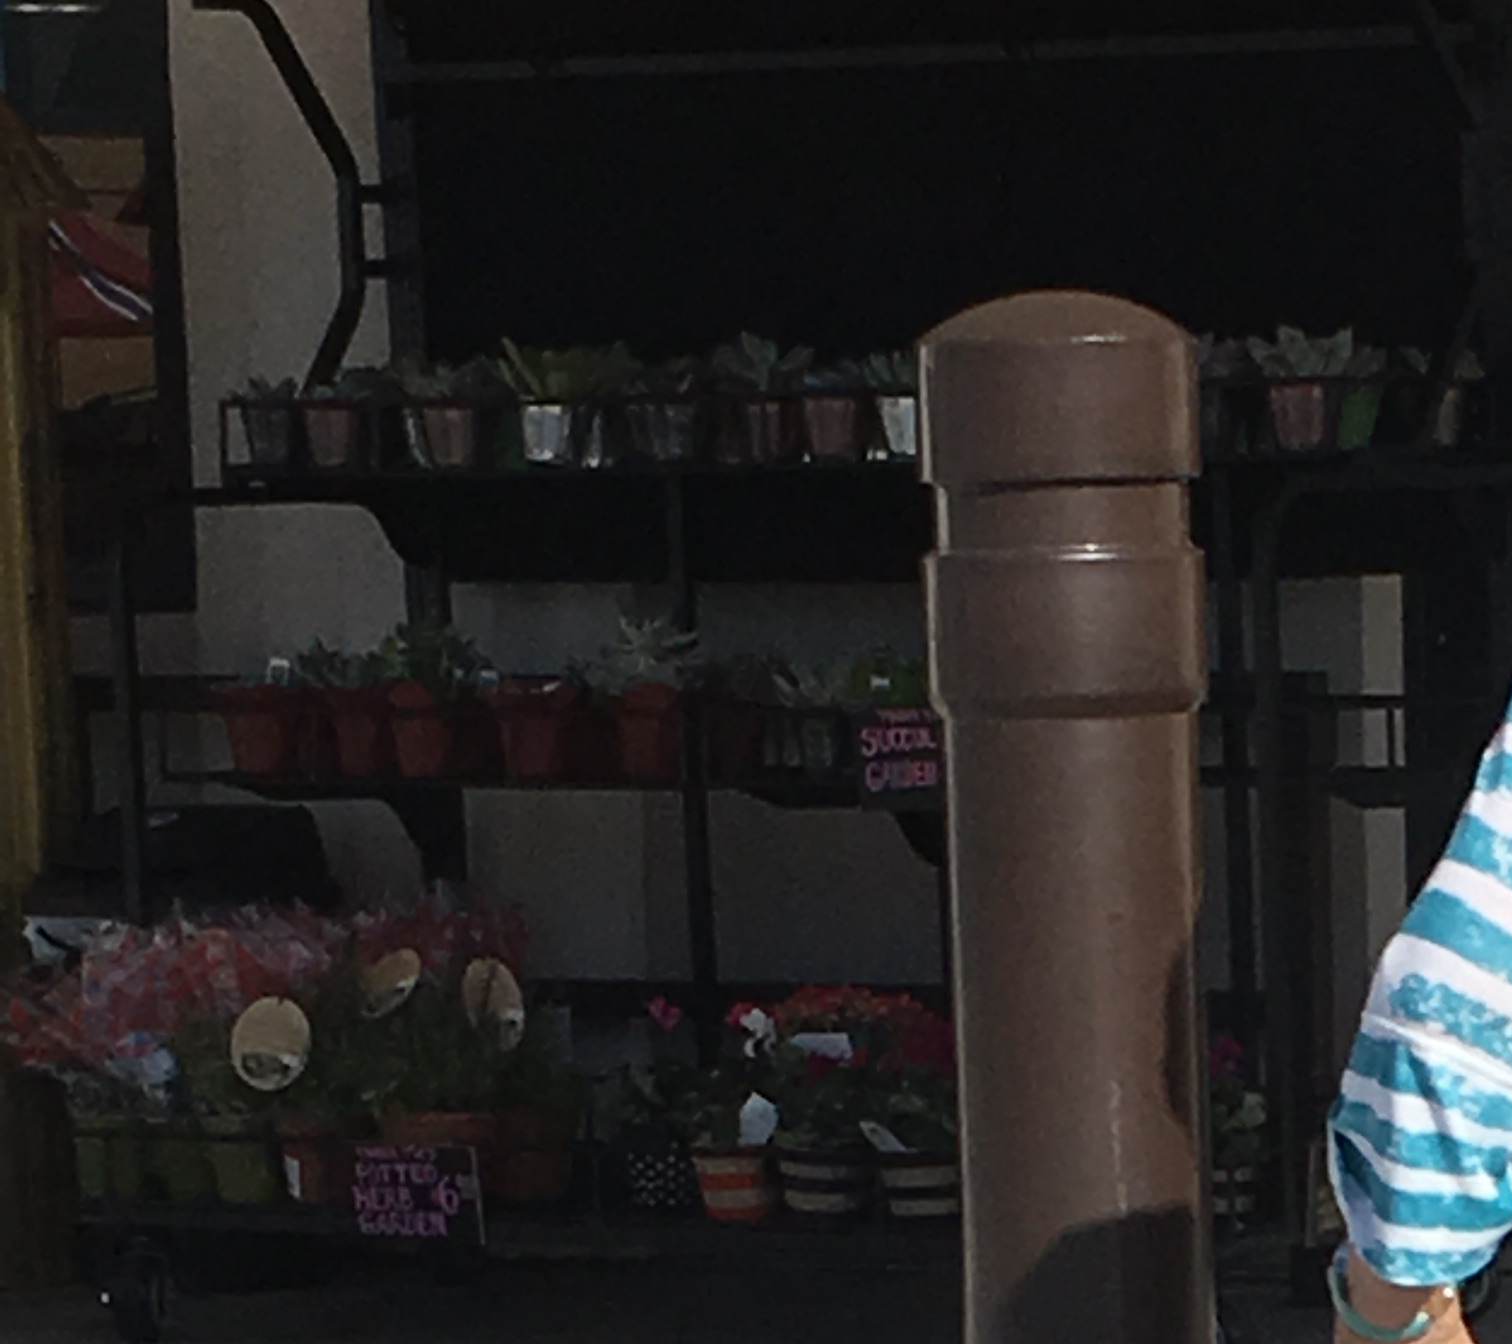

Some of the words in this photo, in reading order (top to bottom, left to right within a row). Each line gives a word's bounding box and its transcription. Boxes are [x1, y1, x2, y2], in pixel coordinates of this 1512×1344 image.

[355, 1163, 438, 1185] POTTED
[352, 1186, 415, 1212] HERB
[357, 1211, 448, 1238] GARDEN
